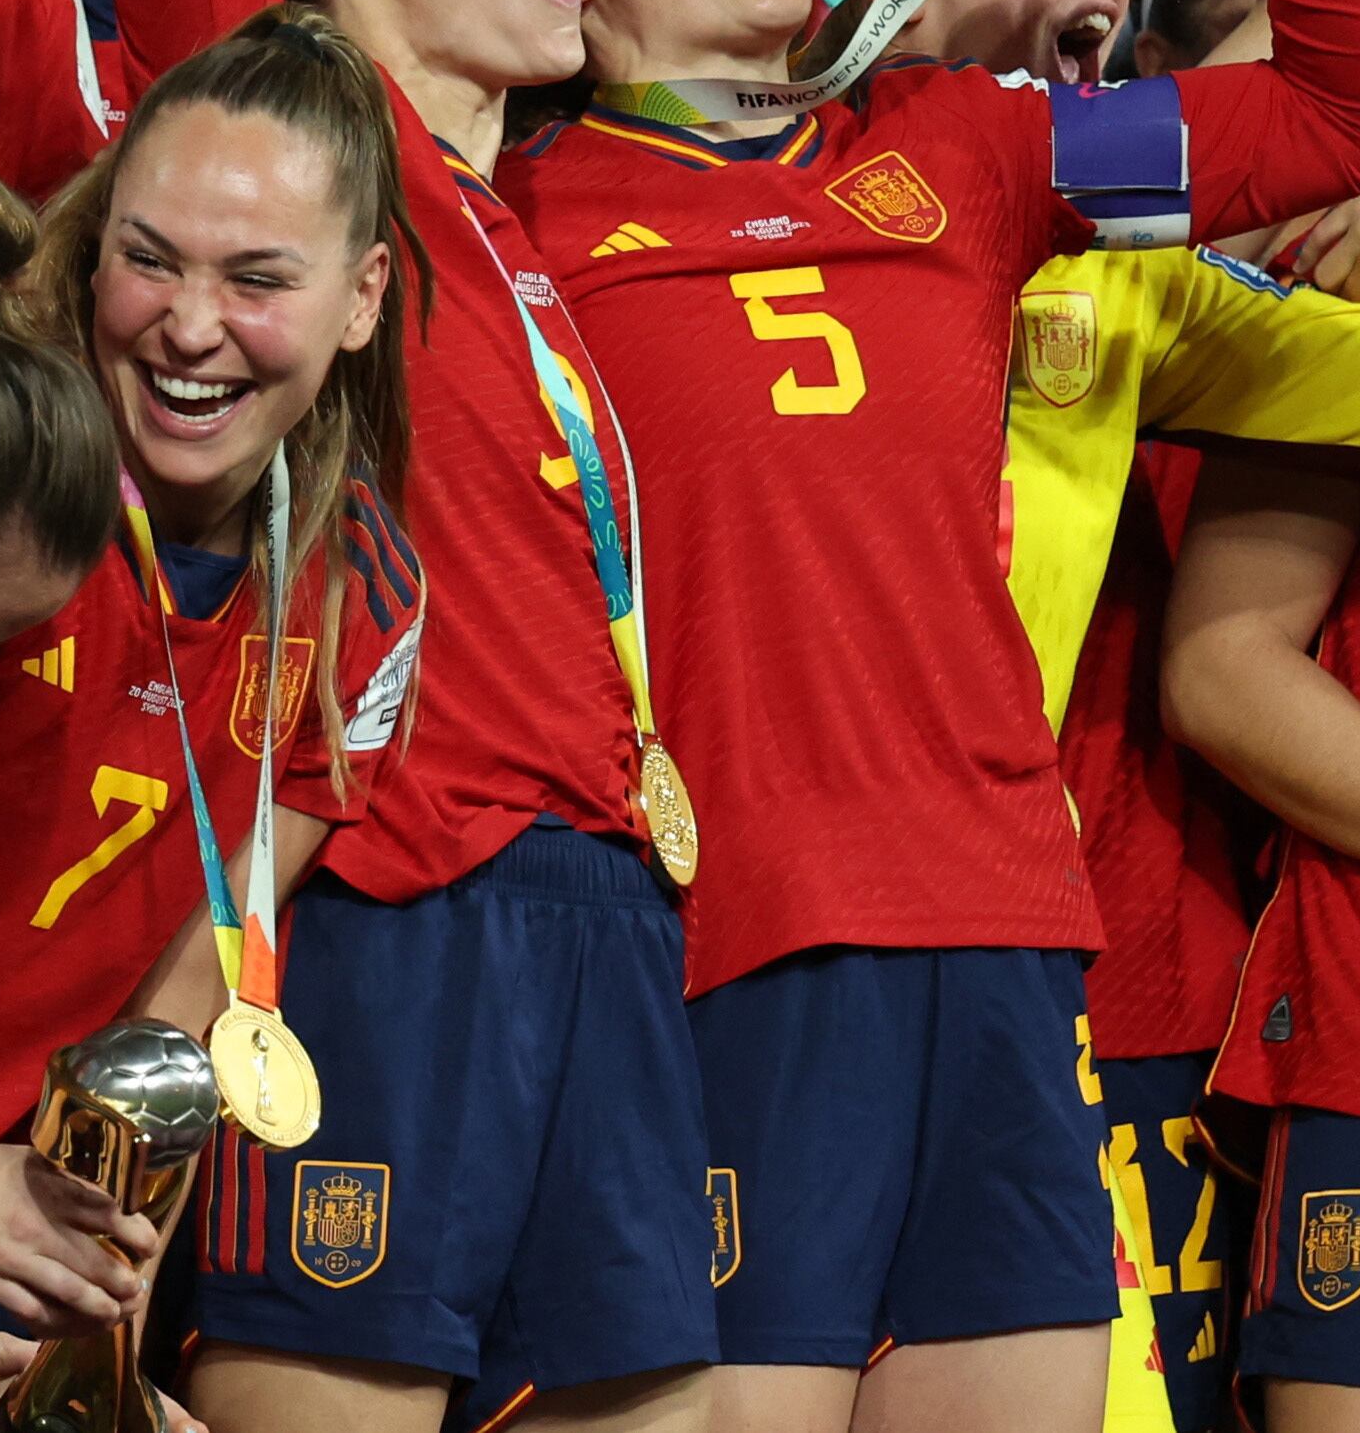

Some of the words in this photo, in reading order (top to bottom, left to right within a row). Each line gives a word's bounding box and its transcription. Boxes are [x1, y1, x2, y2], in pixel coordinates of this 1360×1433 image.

[736, 88, 783, 108] FIFA
[780, 40, 873, 106] WOMEN'S
[744, 215, 790, 230] ENGLAND
[745, 225, 783, 236] AUGUST
[516, 271, 551, 284] ENGLAN
[729, 266, 867, 415] 5
[382, 660, 412, 687] UNIT
[128, 685, 141, 698] 20
[30, 765, 168, 929] 7
